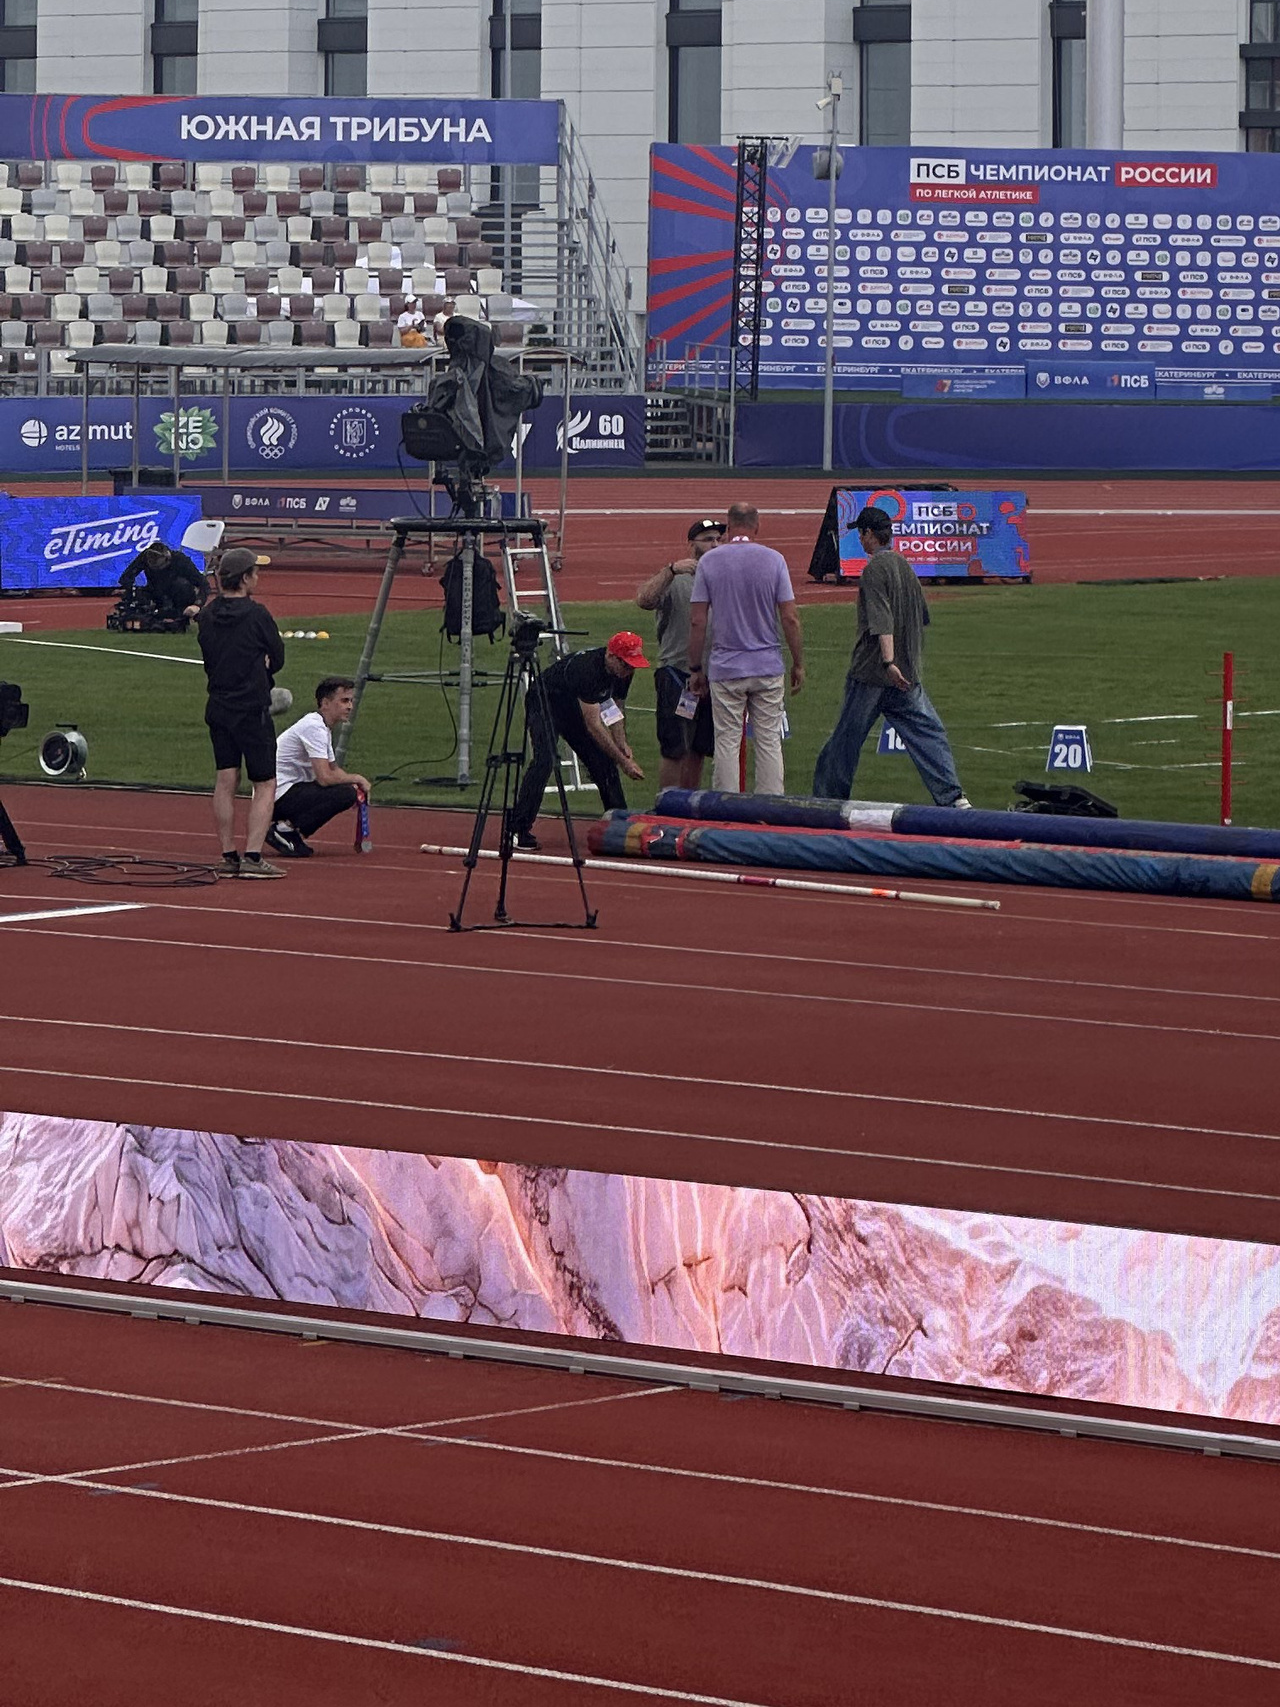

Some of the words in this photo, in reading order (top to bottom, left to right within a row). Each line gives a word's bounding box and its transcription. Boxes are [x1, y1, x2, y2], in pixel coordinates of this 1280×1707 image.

[181, 114, 321, 141] ЮЖНАЯ
[329, 116, 493, 143] ТРИБУНА
[916, 163, 960, 179] ПСБ
[970, 165, 1110, 182] ЧЕМПИОНАТ
[1120, 167, 1212, 184] РОССИИ
[916, 189, 931, 198] ПО
[934, 188, 976, 199] ЛЕГКОЙ
[979, 190, 1033, 200] АТЛЕТИКЕ
[1054, 376, 1089, 385] ВФЛА
[1121, 375, 1149, 388] ПСБ
[55, 421, 133, 440] azmut
[171, 417, 203, 432] ZE
[598, 414, 625, 435] 60
[171, 433, 203, 449] NO
[244, 497, 270, 506] ВФЛА
[286, 497, 306, 509] ПСБ
[917, 505, 953, 517] ПСБ
[891, 523, 990, 535] ЕМПИОНАТ
[44, 520, 162, 559] eTiming
[899, 540, 973, 552] РОССИИ
[1053, 743, 1083, 768] 20
